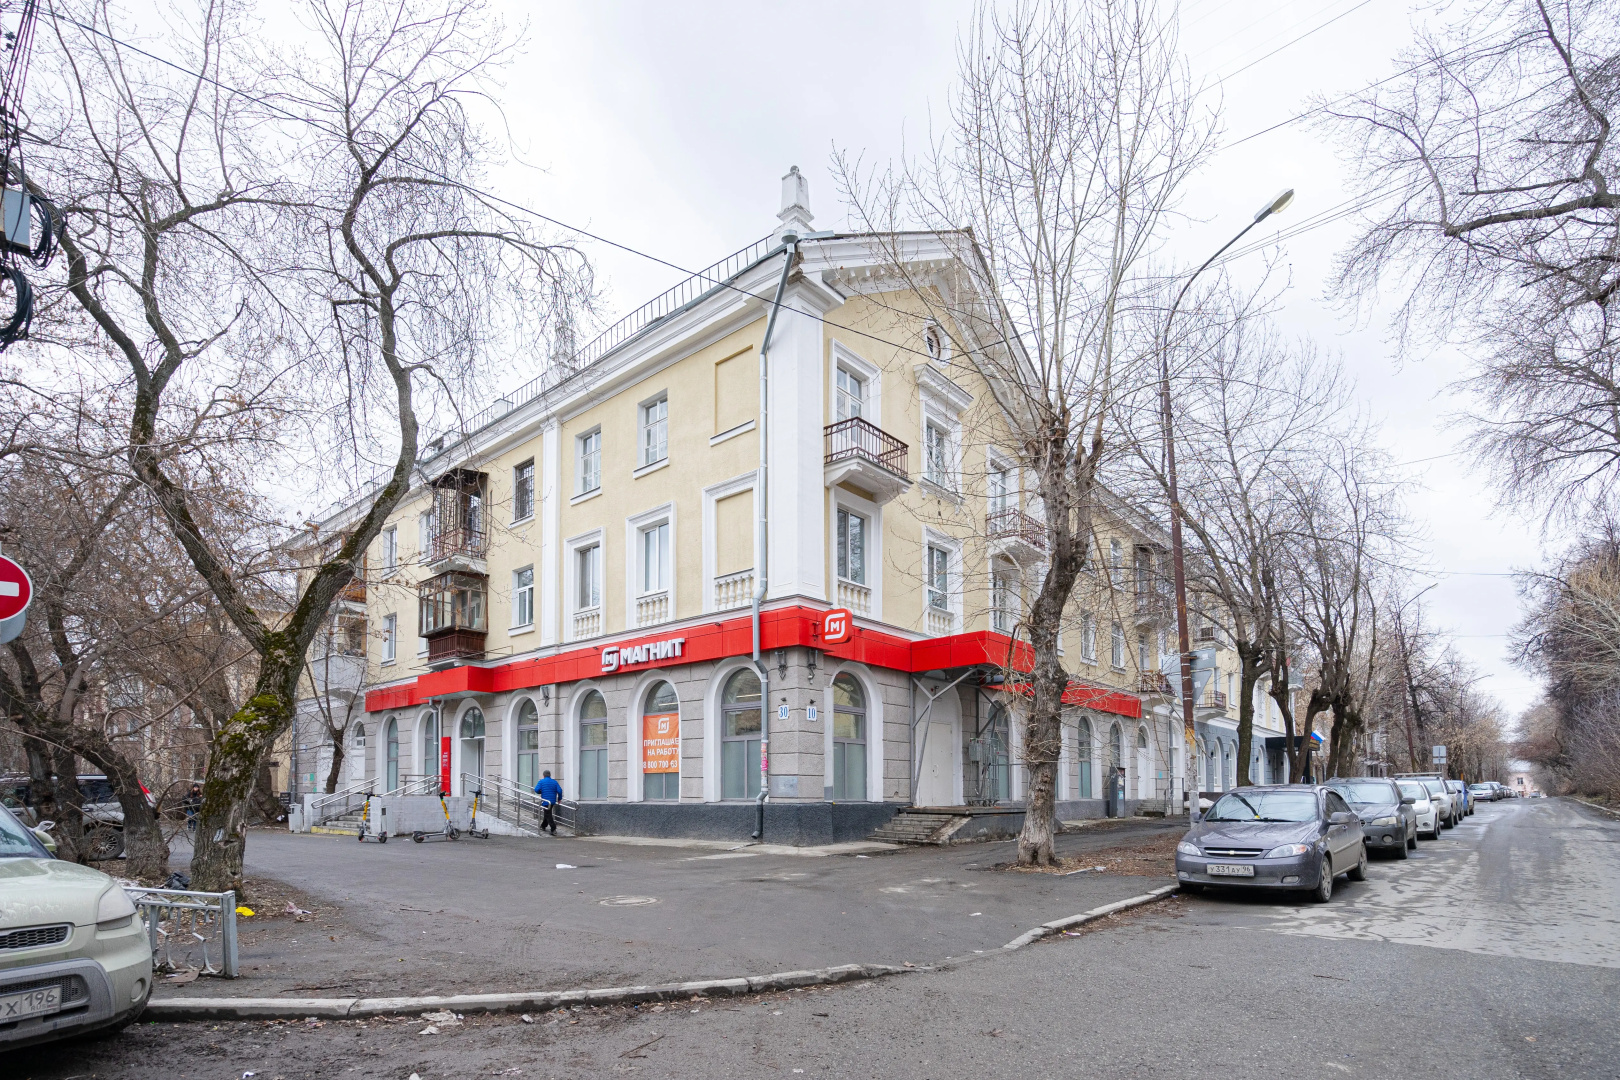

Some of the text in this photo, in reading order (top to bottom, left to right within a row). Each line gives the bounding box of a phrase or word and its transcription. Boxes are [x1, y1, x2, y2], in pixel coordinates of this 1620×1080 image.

[620, 638, 685, 665] МАГНИТ
[779, 706, 788, 718] 30
[808, 708, 816, 719] 10
[24, 990, 55, 1006] 196
